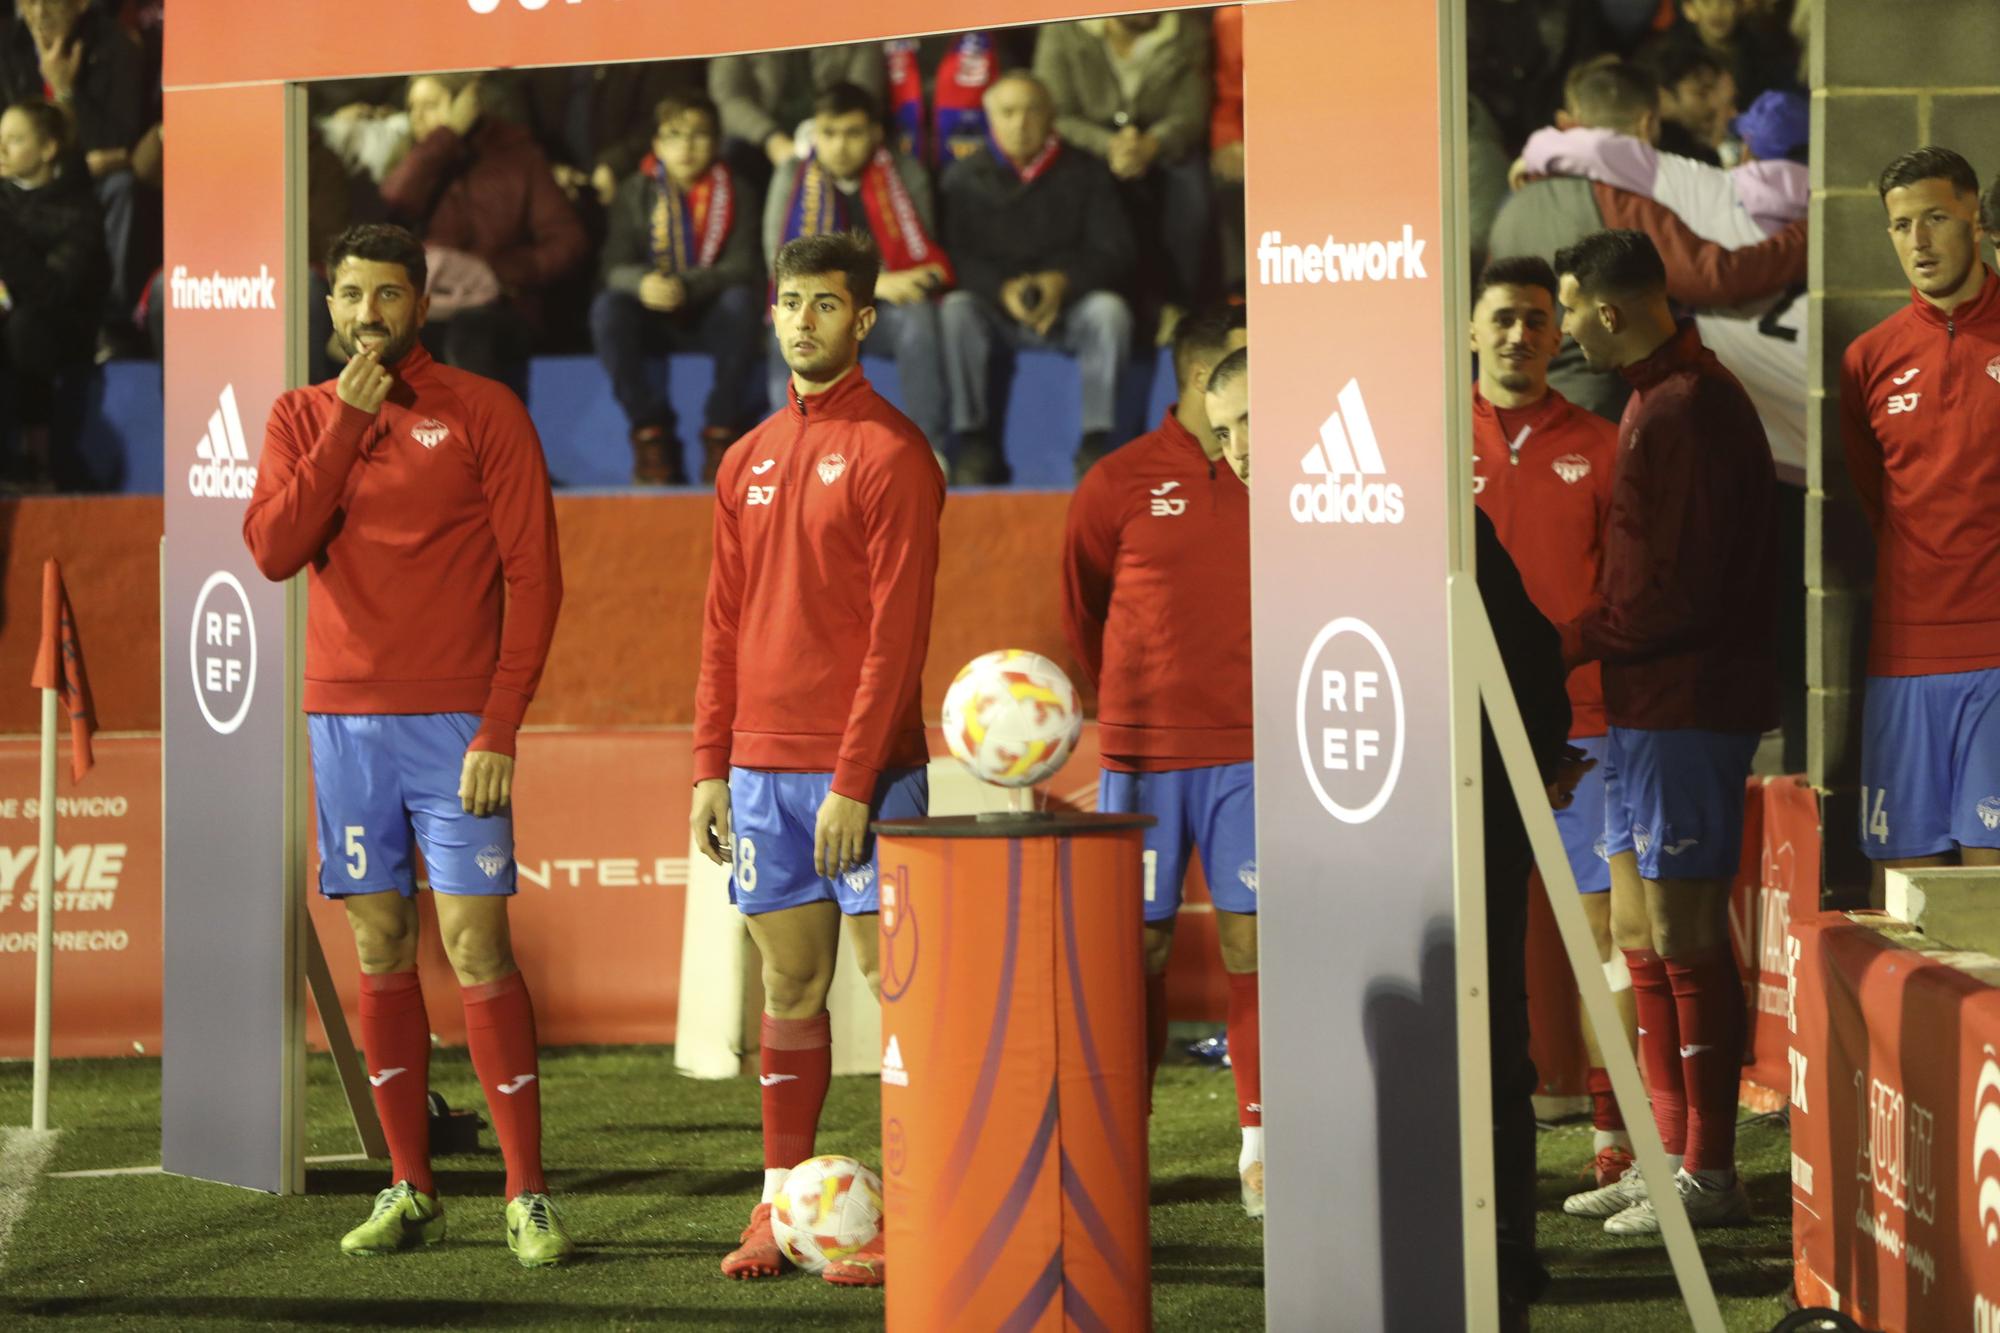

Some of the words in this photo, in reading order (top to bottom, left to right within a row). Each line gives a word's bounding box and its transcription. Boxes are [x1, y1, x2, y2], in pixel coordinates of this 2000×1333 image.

[1257, 224, 1428, 285] finetwork
[170, 264, 276, 310] finetwork
[188, 456, 258, 499] adidas
[1289, 471, 1405, 524] adidas
[22, 796, 129, 819] SRVICIO
[344, 825, 367, 880] 5
